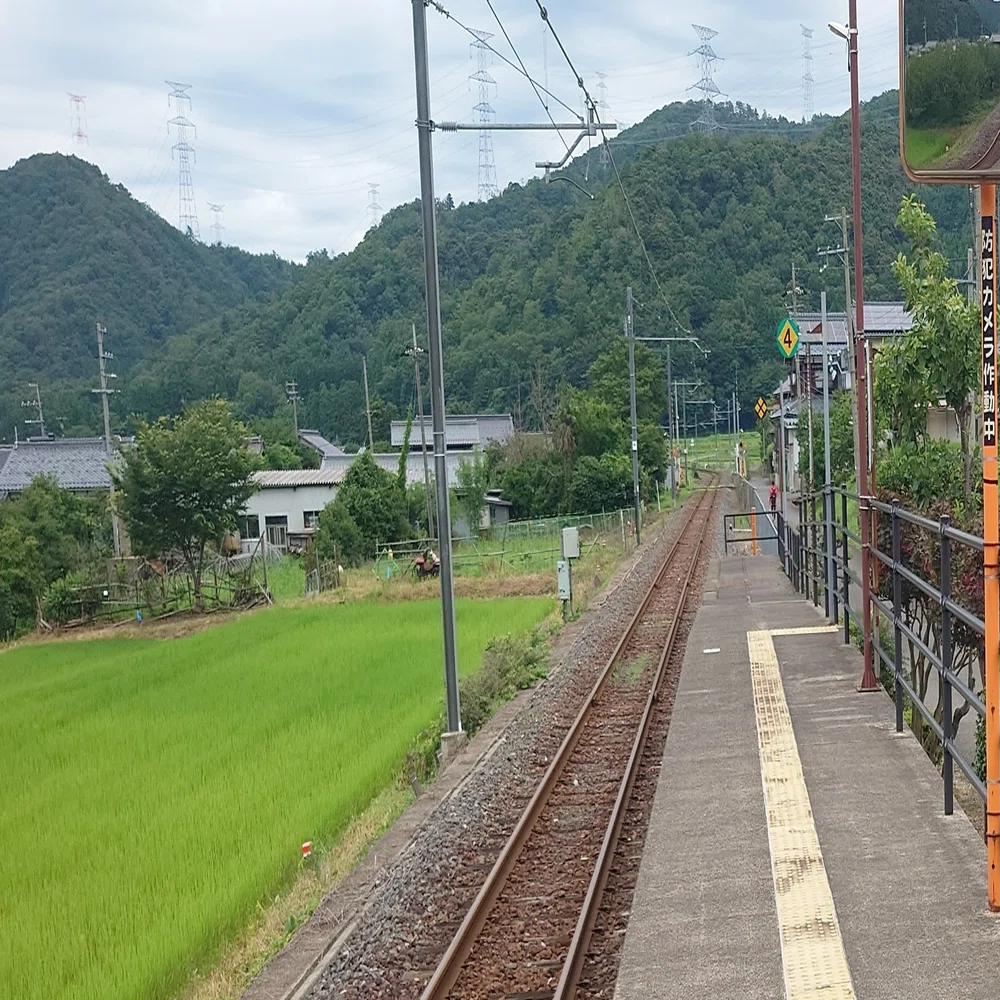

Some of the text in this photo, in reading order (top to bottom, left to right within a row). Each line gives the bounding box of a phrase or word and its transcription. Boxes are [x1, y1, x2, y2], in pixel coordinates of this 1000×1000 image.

[783, 328, 792, 348] 4
[981, 229, 996, 441] 防犯カメラ作動中
